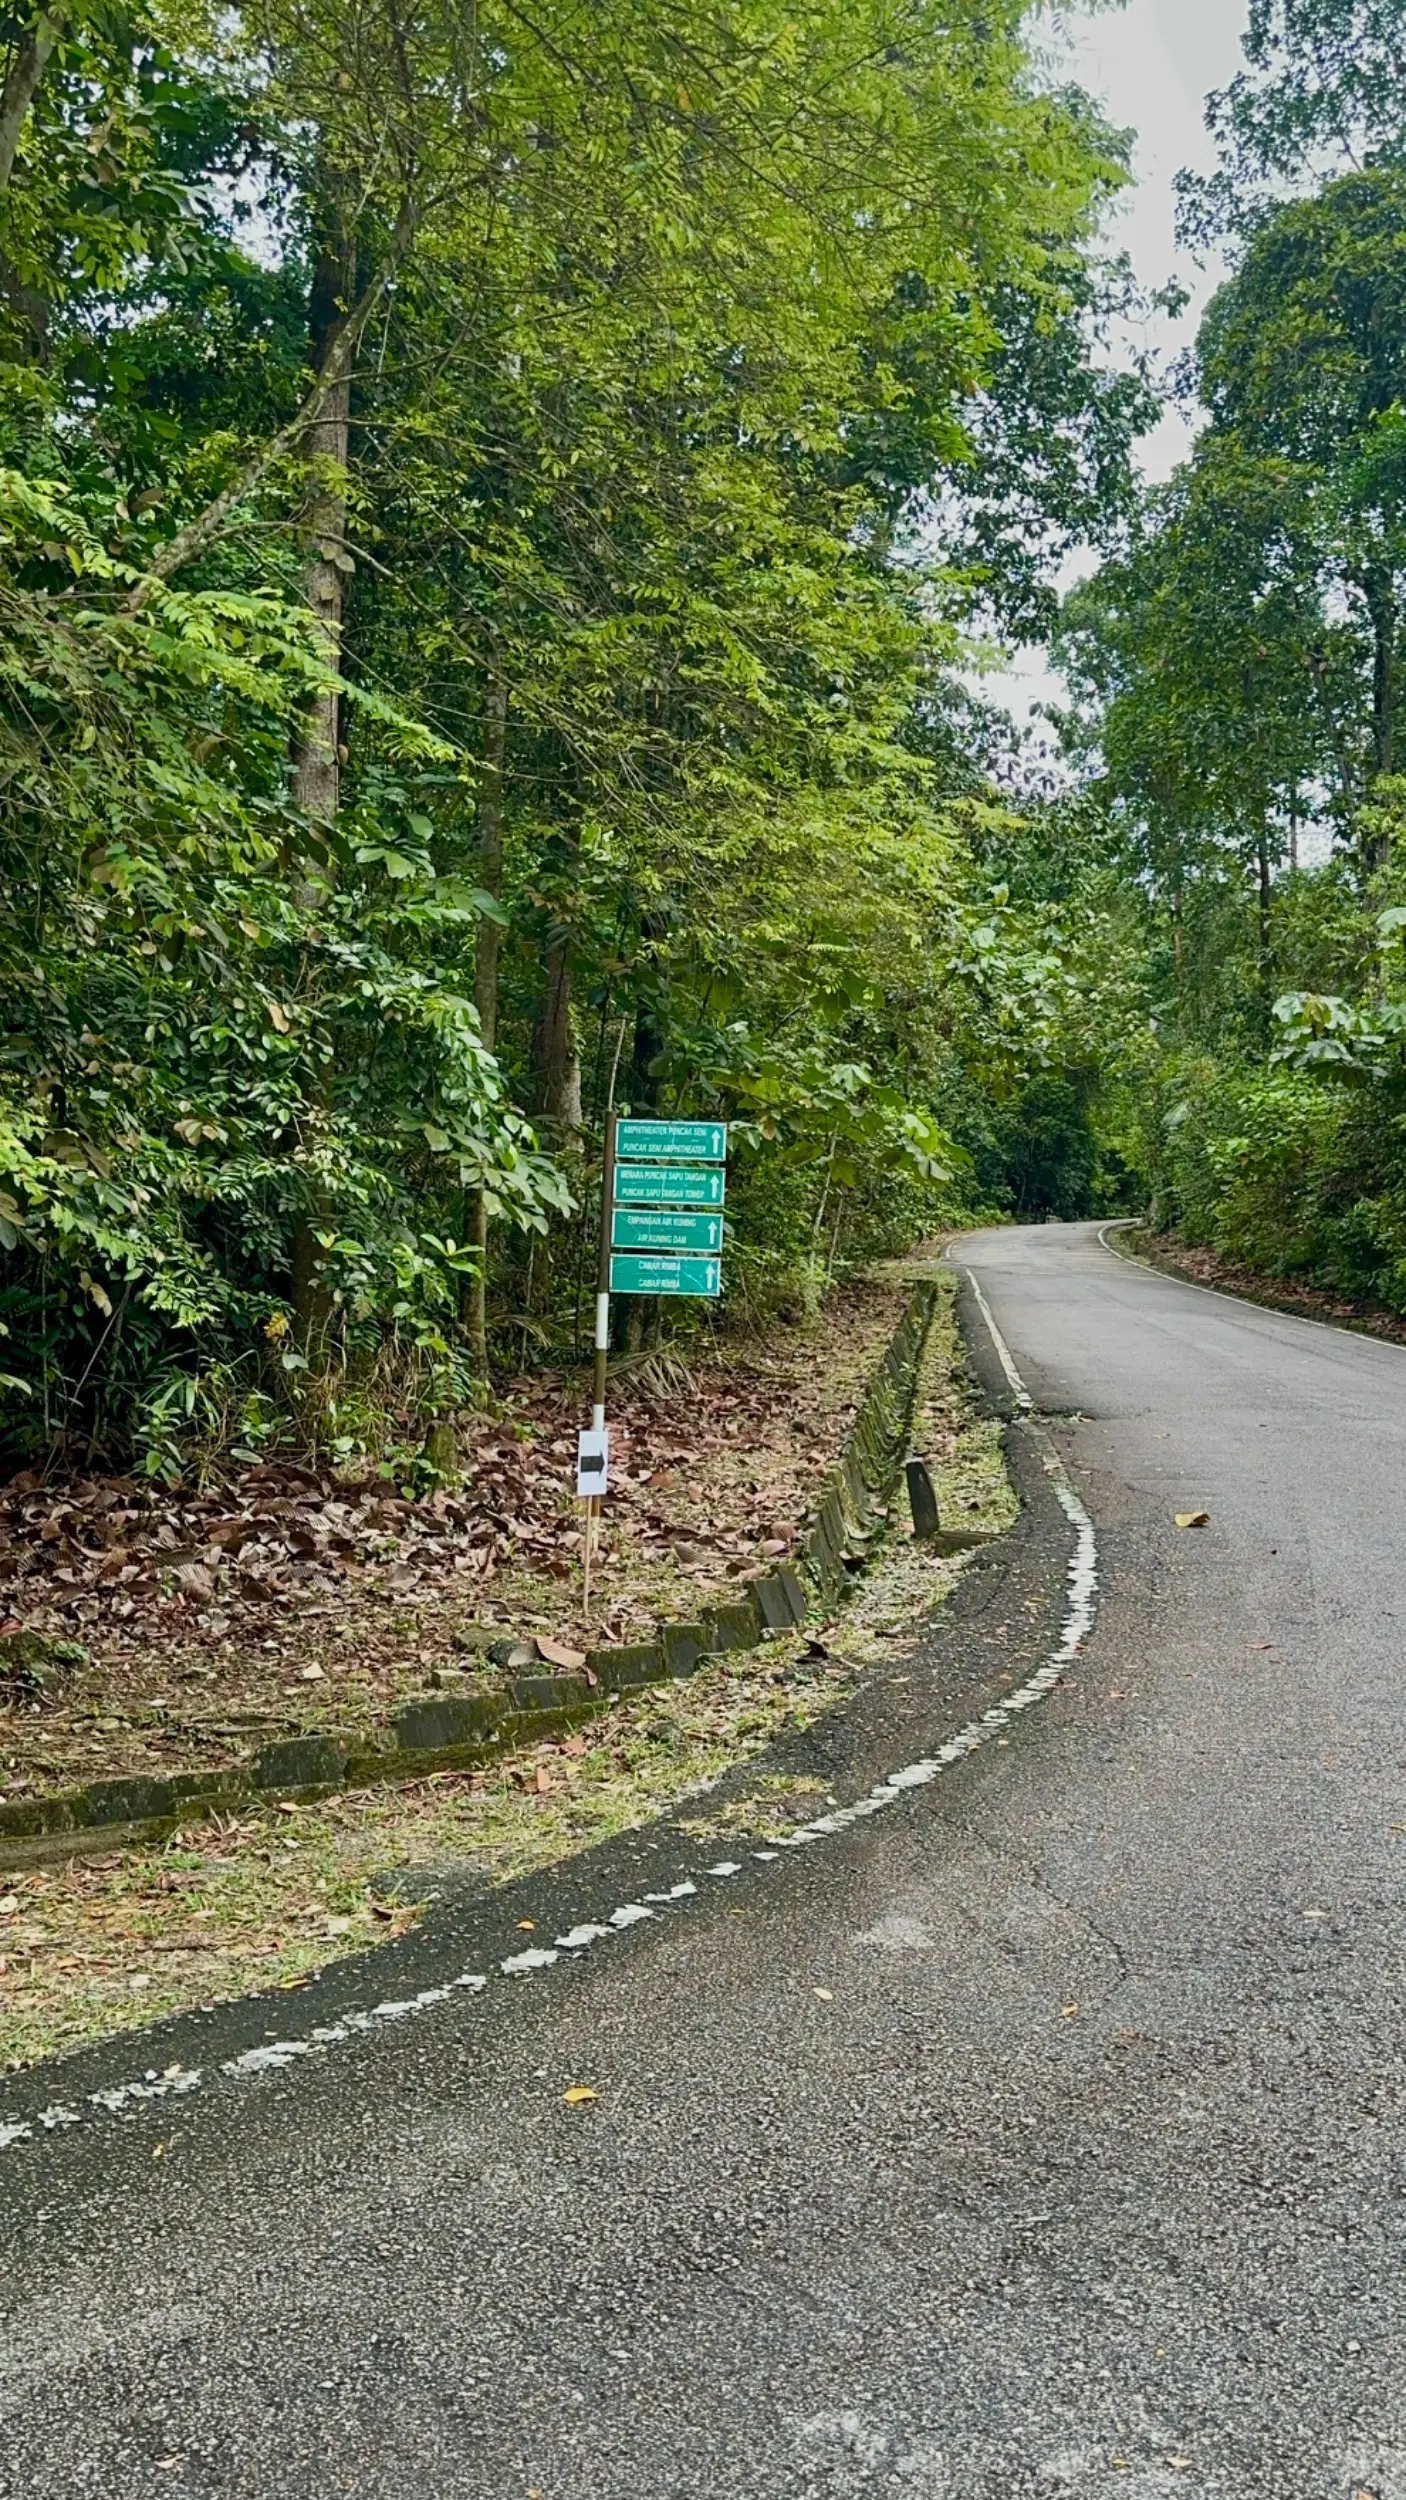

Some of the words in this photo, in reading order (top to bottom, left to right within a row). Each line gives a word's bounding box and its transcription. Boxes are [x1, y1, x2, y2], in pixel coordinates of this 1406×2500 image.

[623, 1143, 647, 1152] PUNCAK
[668, 1171, 684, 1180] SAPU
[645, 1189, 661, 1198] SAPU
[661, 1217, 673, 1226] AIR
[637, 1234, 648, 1242] AIR
[673, 1236, 687, 1244] DAM
